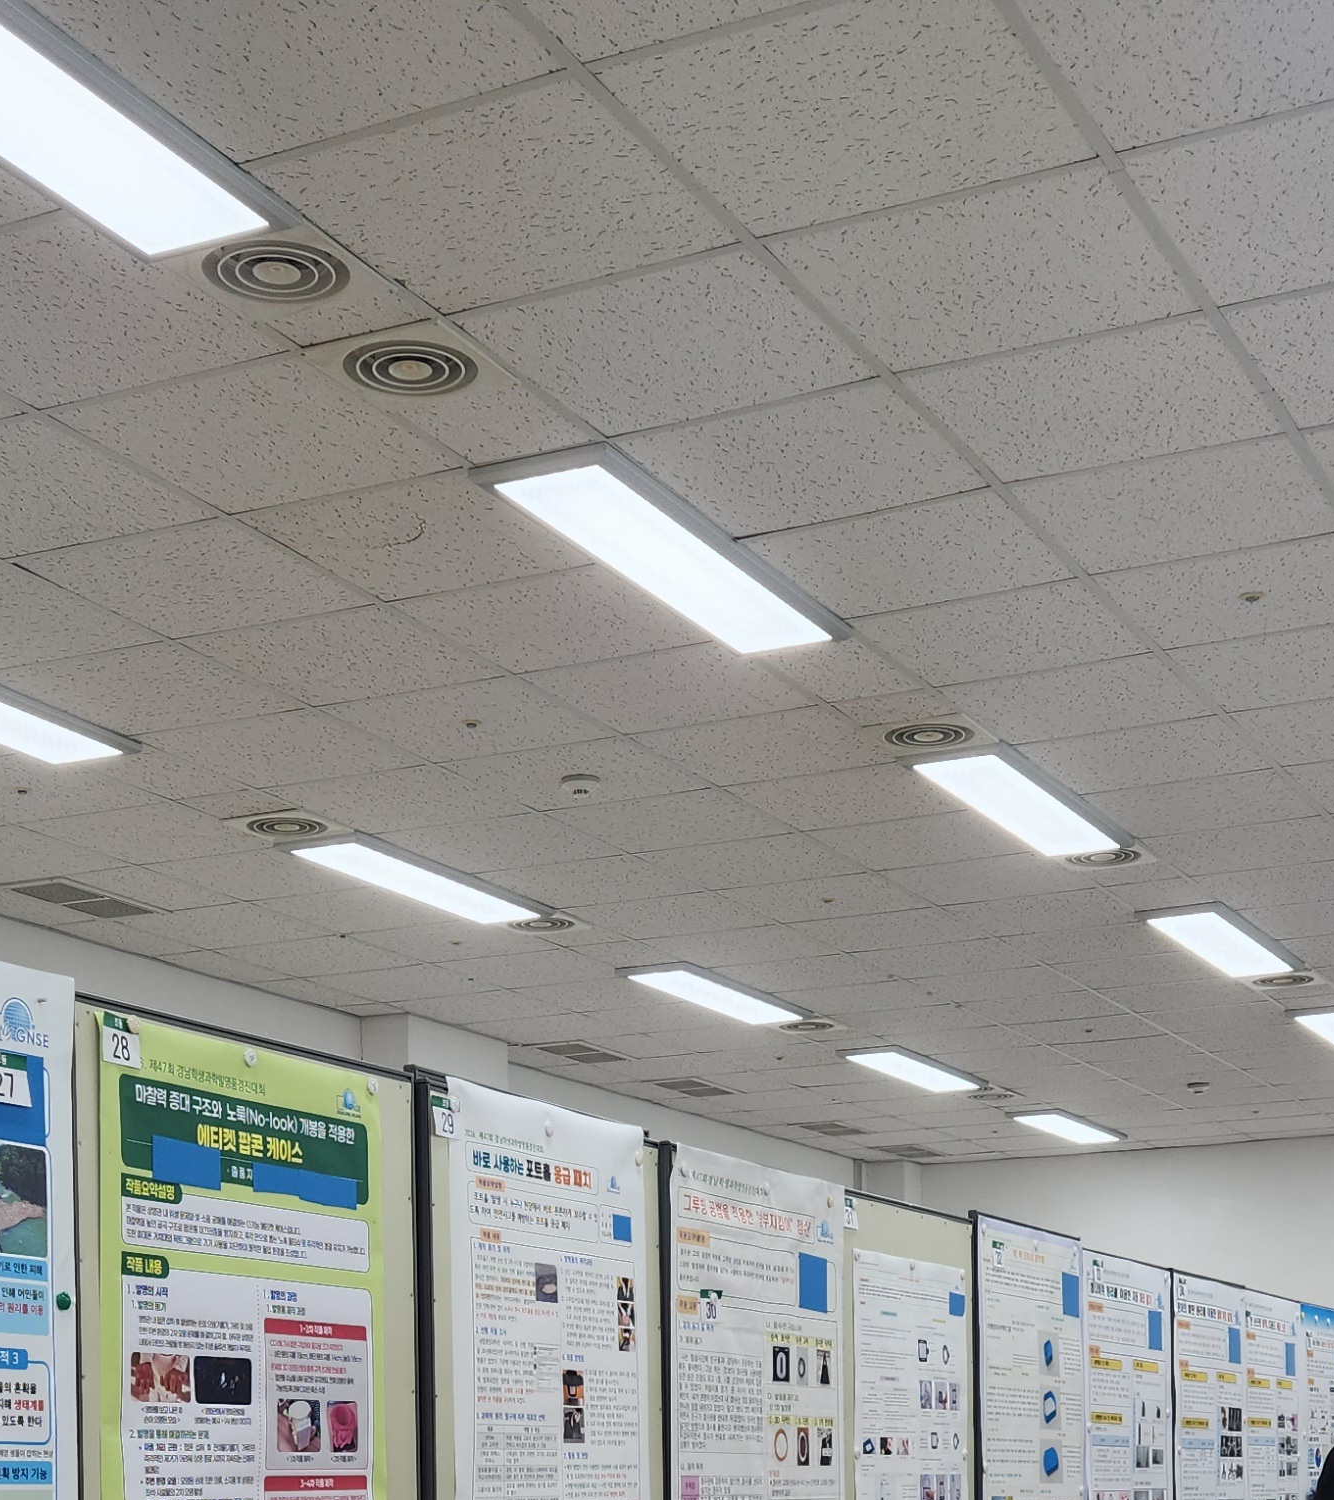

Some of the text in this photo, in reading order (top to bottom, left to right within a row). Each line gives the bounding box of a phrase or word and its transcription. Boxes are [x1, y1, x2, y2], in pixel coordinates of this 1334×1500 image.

[111, 1033, 131, 1062] 28
[135, 1083, 167, 1108] 마찰력
[169, 1089, 190, 1112] 증대
[192, 1096, 223, 1119] 구조와
[299, 1117, 327, 1140] 개봉을
[328, 1121, 355, 1145] 적용한
[441, 1112, 455, 1135] 29
[196, 1123, 304, 1164] 에티켓 팝콘 케이스
[472, 1149, 492, 1169] 바로
[493, 1153, 524, 1176] 사용하는
[525, 1158, 552, 1182] 포트홀
[553, 1165, 571, 1186] 응급
[125, 1257, 163, 1276] 작품 내용
[705, 1301, 717, 1320] 30
[12, 1352, 19, 1365] 3
